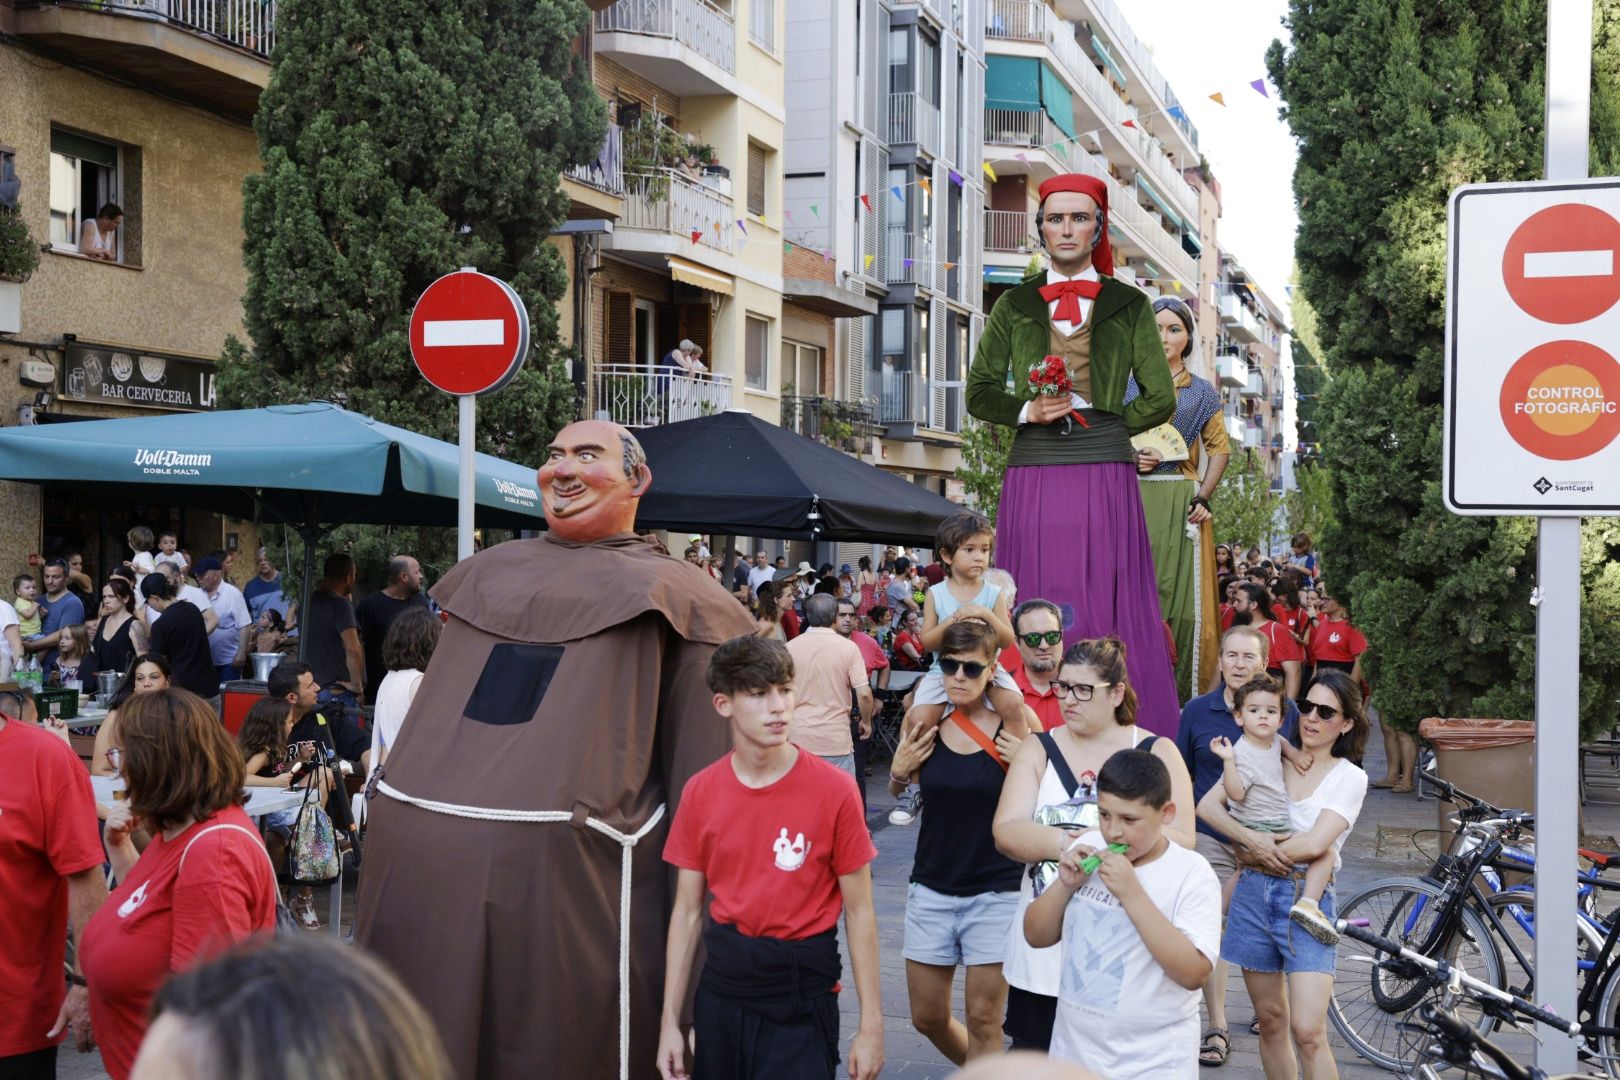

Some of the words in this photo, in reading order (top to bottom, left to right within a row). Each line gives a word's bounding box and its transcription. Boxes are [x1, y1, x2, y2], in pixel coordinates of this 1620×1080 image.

[102, 383, 124, 398] BAR
[126, 385, 192, 404] CERVECERIA
[1527, 386, 1604, 399] CONTROL
[1514, 400, 1617, 414] FOTOGRÀFIC
[133, 448, 211, 467] Voll-Damm
[173, 468, 200, 476] MALTA
[492, 477, 538, 500] Voll-Damm
